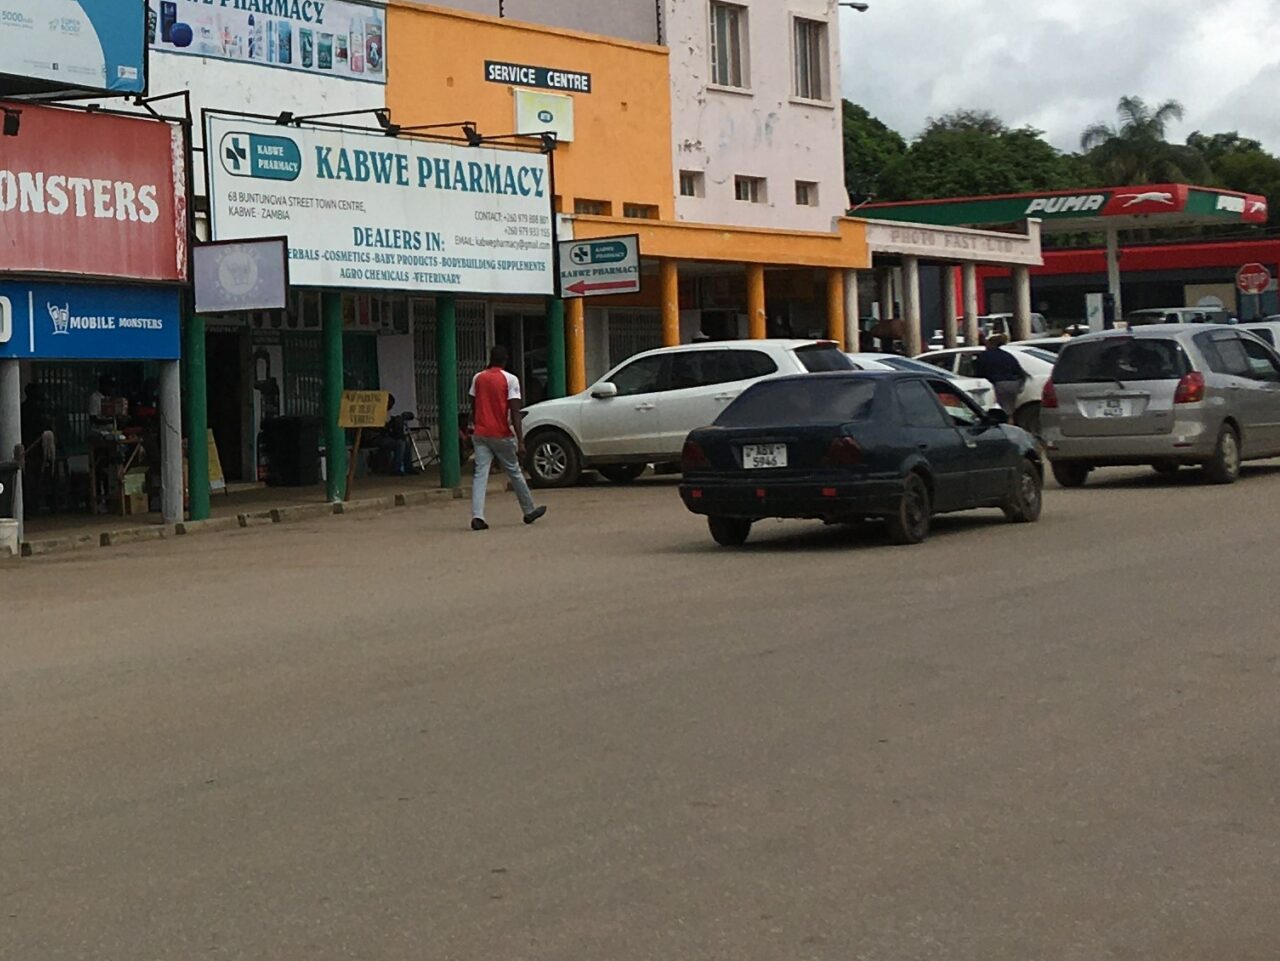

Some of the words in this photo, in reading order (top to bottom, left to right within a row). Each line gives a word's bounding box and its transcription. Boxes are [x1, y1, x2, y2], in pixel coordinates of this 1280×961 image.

[488, 64, 536, 84] SERVICE
[546, 71, 588, 90] CENTRE
[257, 144, 285, 157] KABWE
[258, 158, 298, 172] PHARMACY
[315, 145, 410, 187] KABWE
[416, 155, 544, 198] PHARMACY
[288, 196, 314, 208] STREET
[314, 198, 337, 209] TOWN
[338, 200, 367, 213] CENTRE,
[1024, 194, 1105, 215] PUMA
[228, 207, 257, 218] KABWE
[261, 208, 290, 220] ZAMBIA
[353, 226, 421, 251] DEALERS
[426, 232, 446, 253] IN:
[890, 230, 936, 246] PHOTO
[944, 234, 977, 249] FAST
[396, 254, 439, 267] PRODUCTS
[497, 260, 546, 272] SUPPLEMENTS
[339, 268, 363, 280] AGRO
[364, 269, 410, 282] CHEMICALS
[561, 269, 591, 279] KABWE
[592, 265, 638, 276] PHARMACY
[1239, 272, 1267, 286] STOP
[70, 316, 116, 330] MOBILE
[118, 317, 163, 330] MONSTERS
